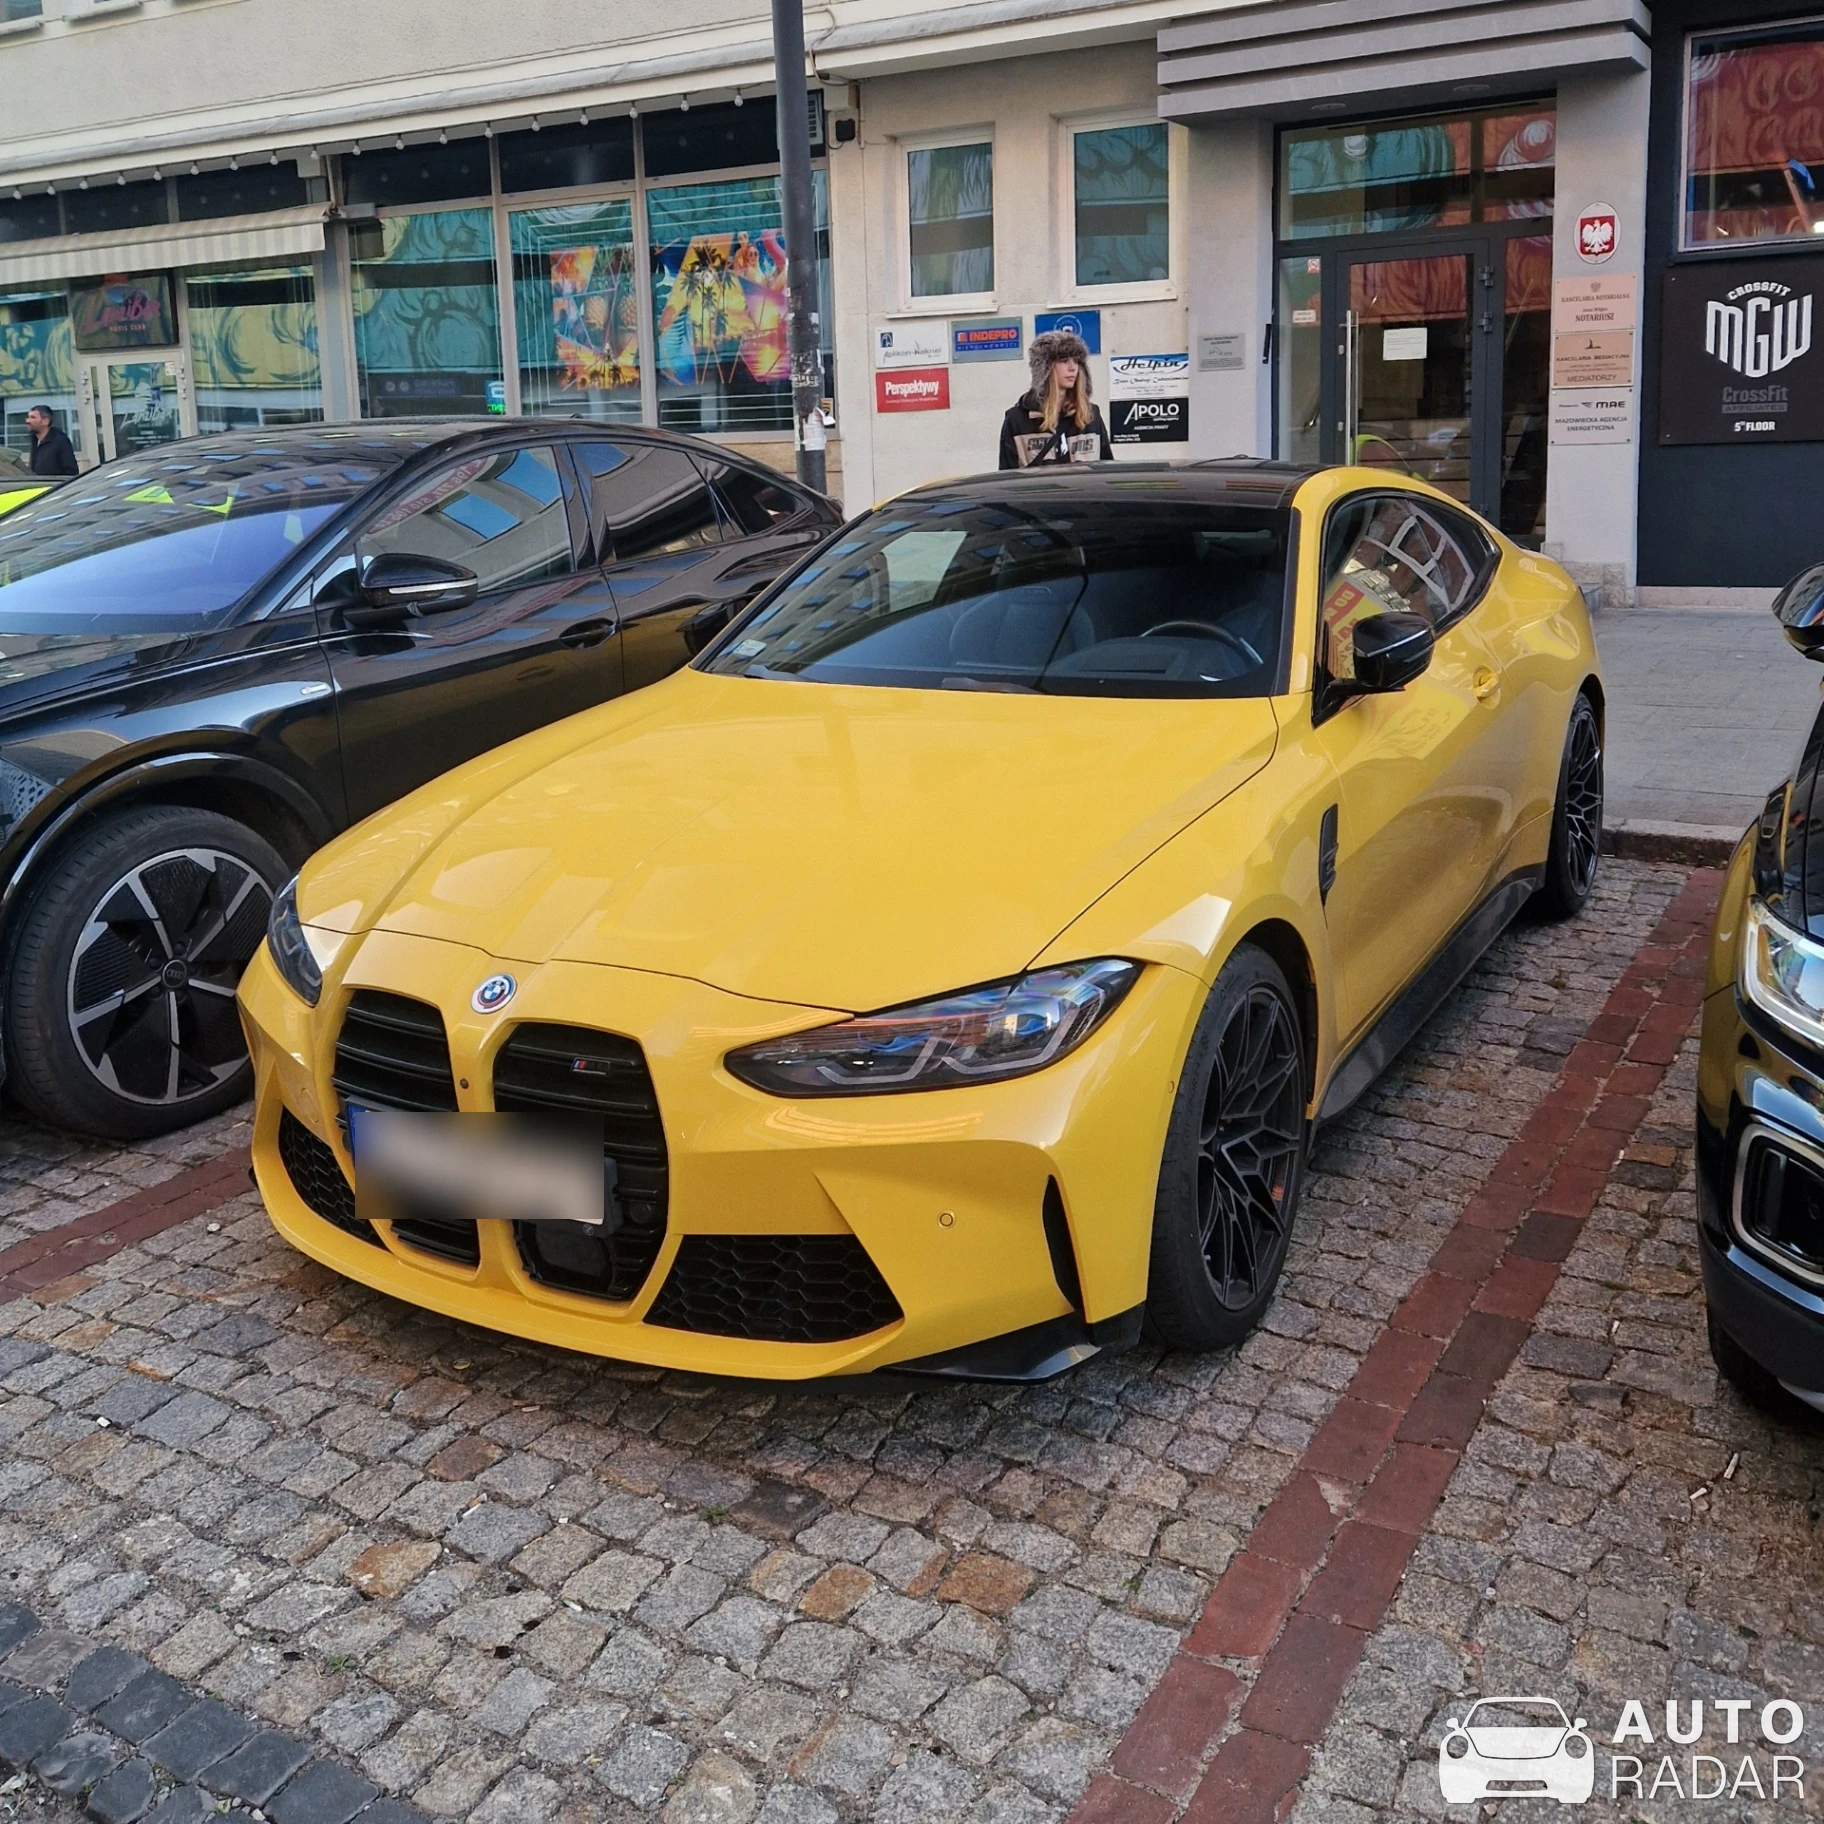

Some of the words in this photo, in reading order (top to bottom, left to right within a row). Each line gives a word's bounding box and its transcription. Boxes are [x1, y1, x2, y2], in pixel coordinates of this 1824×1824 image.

[1727, 281, 1792, 301] CROSSFIT
[1575, 312, 1615, 322] NOTARIUSZ
[969, 328, 1018, 342] INDEPRO
[1705, 294, 1813, 378] MGW
[1567, 373, 1617, 383] MEDIATORZY
[885, 379, 940, 398] Perspektywy
[1723, 385, 1789, 402] CrossFit
[1595, 400, 1627, 409] MAE
[1123, 402, 1180, 426] APOLO
[1567, 424, 1615, 432] ENERGETYCZNA
[1746, 421, 1776, 431] FLOOR
